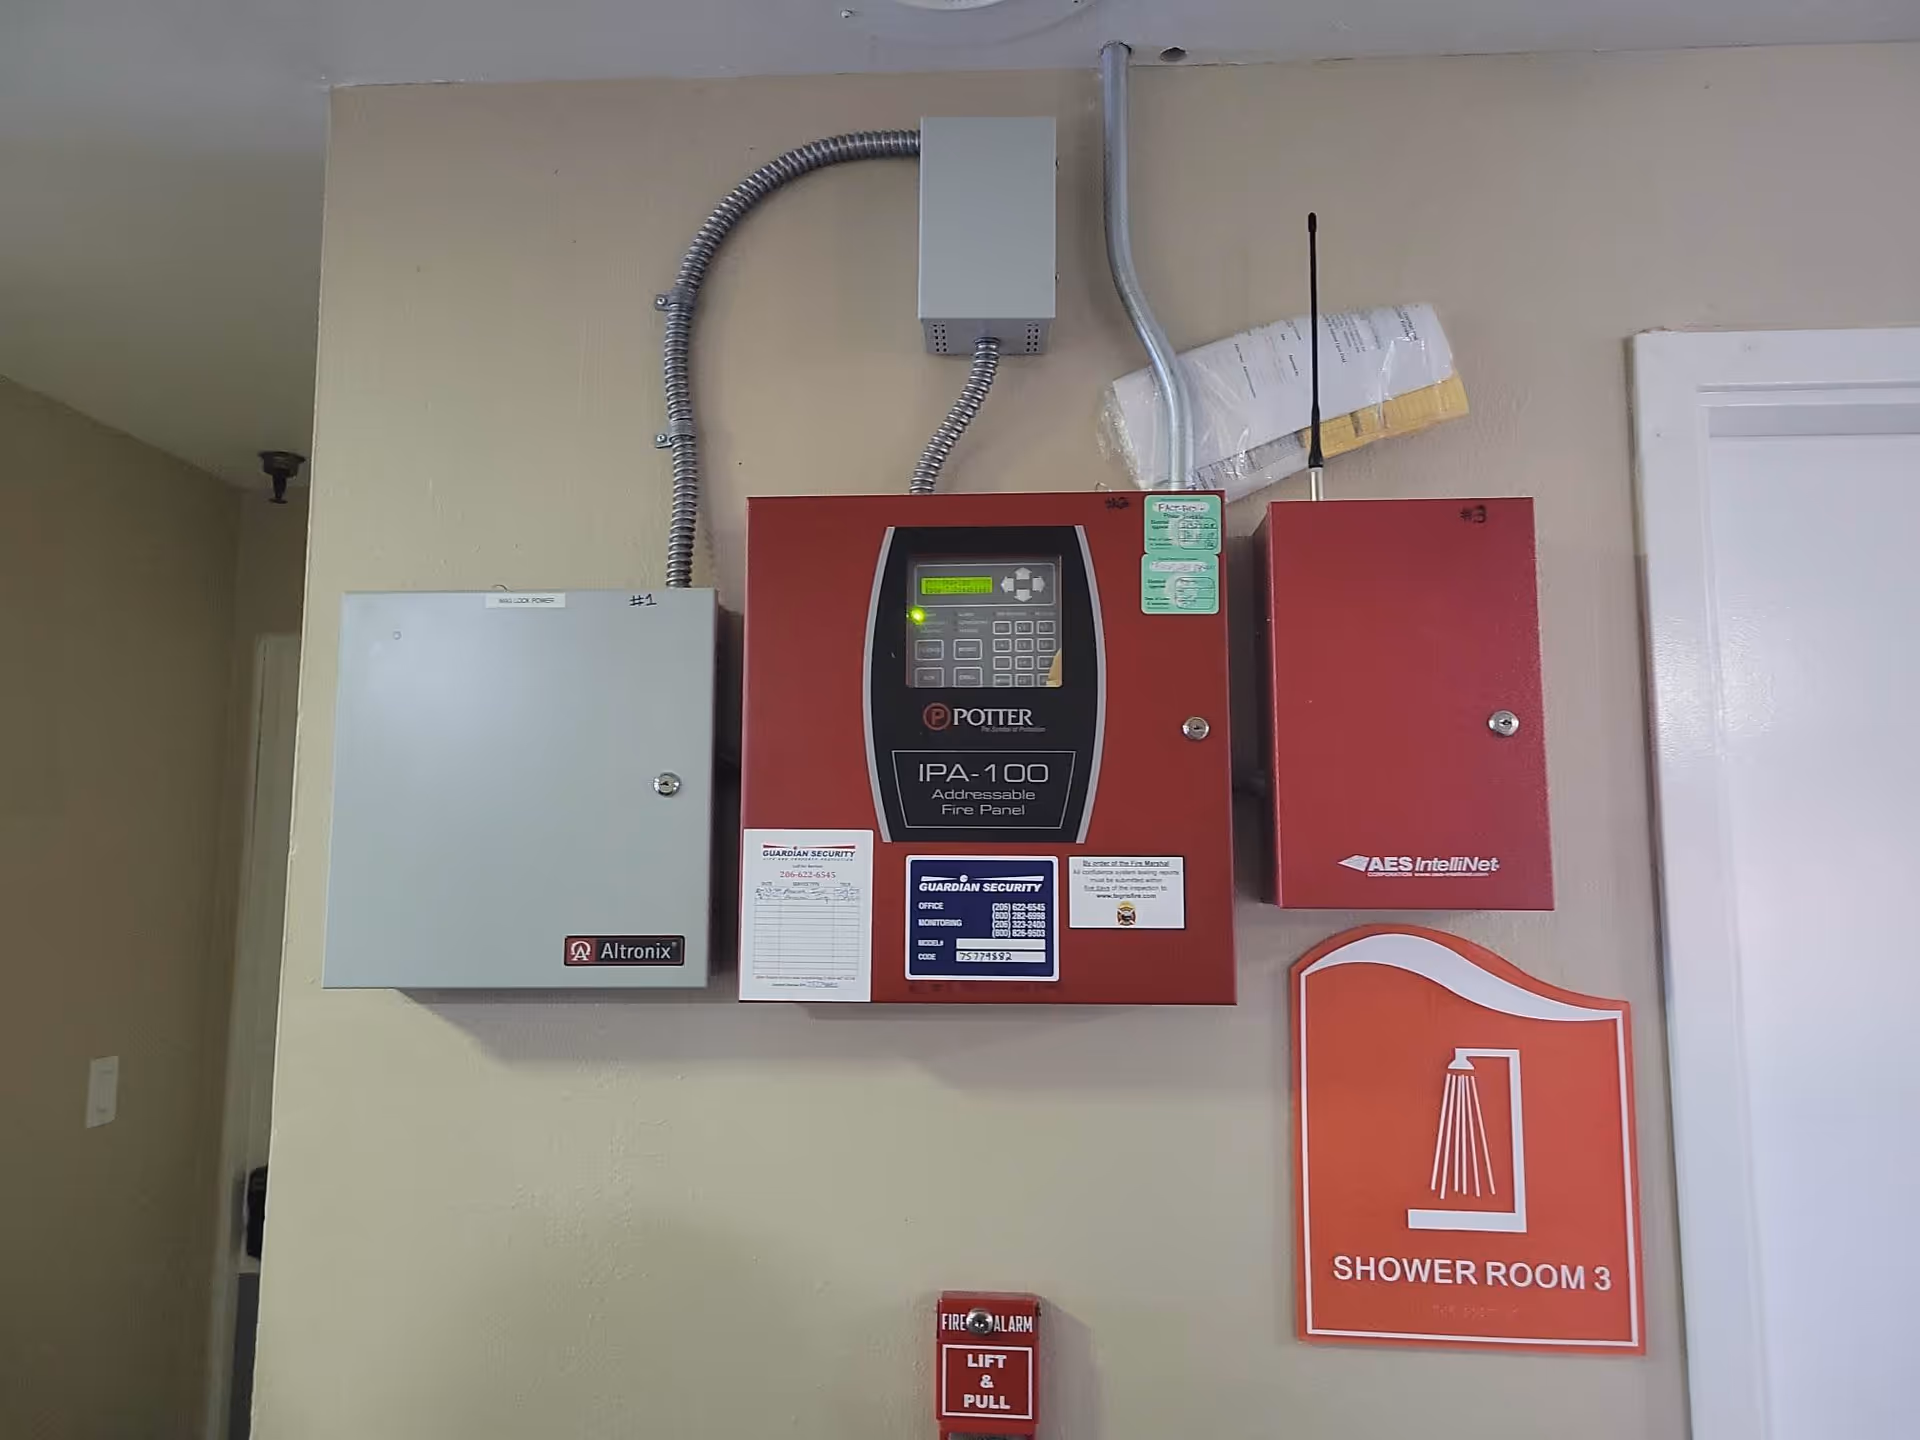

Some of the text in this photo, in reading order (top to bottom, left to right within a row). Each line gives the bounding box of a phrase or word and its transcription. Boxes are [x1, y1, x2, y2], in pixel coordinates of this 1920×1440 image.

[629, 594, 657, 606] #1
[953, 708, 1033, 726] POTTER
[918, 763, 1049, 783] IPA-100
[931, 789, 1036, 800] Addressable
[942, 804, 1025, 815] Fire Panel
[1367, 856, 1499, 872] AES IntelliNet
[780, 871, 836, 879] 206-622-6545
[919, 882, 1042, 893] GUARDIAN SECURITY
[918, 902, 944, 910] OFFICE
[918, 918, 963, 927] MONITORING
[600, 942, 671, 960] Altronix
[1333, 1255, 1612, 1291] SHOWER ROOM 3
[942, 1313, 1033, 1333] FIRE ALARM
[967, 1353, 1007, 1369] LIFT
[980, 1374, 994, 1389] &
[963, 1393, 1011, 1410] PULL
